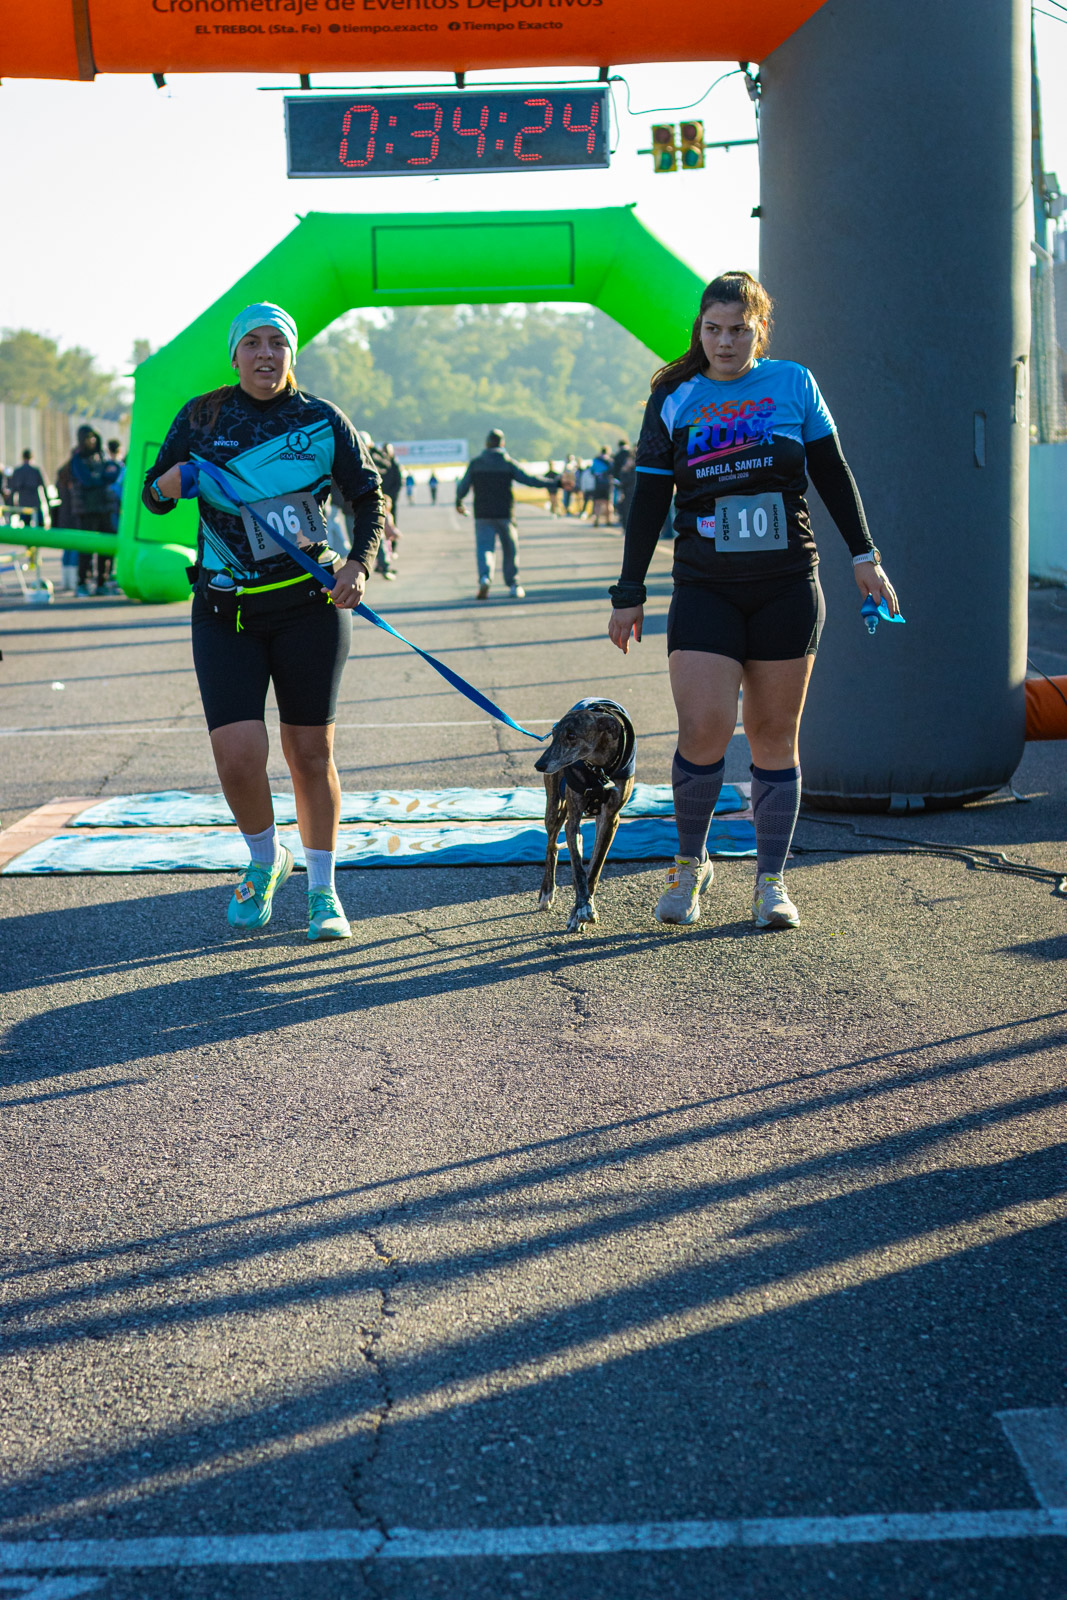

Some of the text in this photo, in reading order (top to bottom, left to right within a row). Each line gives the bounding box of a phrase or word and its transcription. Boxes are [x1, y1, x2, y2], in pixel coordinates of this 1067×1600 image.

[152, 0, 604, 15] Cronometraje de Eventos Deportivos
[195, 23, 322, 34] EL TREBOL (Sta. Fe)
[343, 22, 439, 34] tiempo.exacto
[463, 20, 564, 32] Tiempo Exacto
[339, 98, 598, 167] 0:34:24
[695, 456, 774, 479] RAFAELA, SANTA FE
[722, 507, 730, 541] TIEMPO
[738, 507, 768, 538] 10
[772, 504, 780, 540] EXACTO
